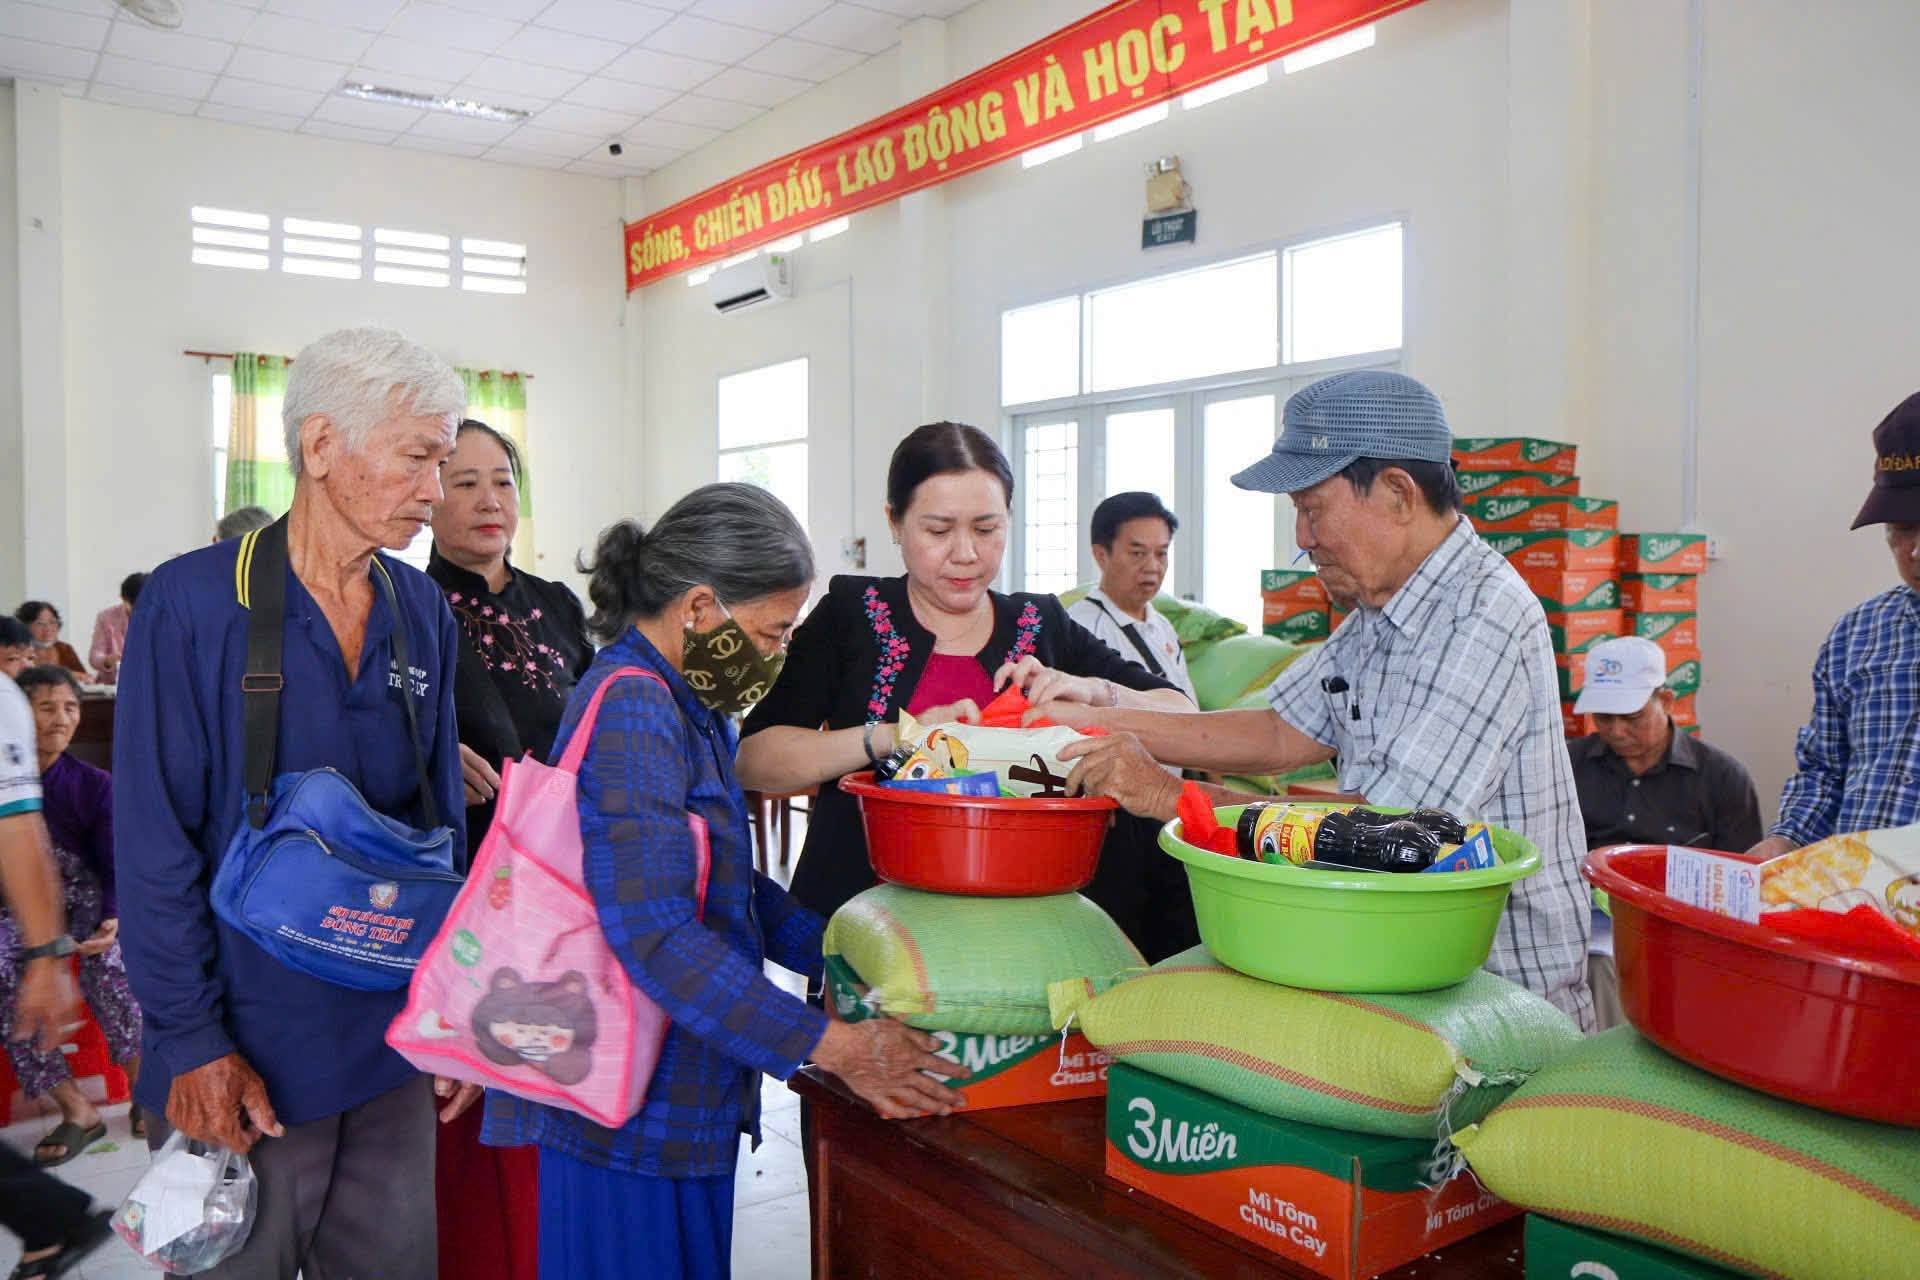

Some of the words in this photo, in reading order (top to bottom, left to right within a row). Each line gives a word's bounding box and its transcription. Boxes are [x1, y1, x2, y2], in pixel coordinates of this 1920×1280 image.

[630, 223, 690, 275] SỐNG,
[693, 186, 764, 250] CHIẾN
[767, 159, 833, 223] ĐẤU,
[837, 135, 896, 197] LAO
[902, 91, 1008, 172] ĐỘNG
[1013, 54, 1075, 127] VÀ
[1082, 13, 1187, 103] HỌC
[1050, 1071, 1097, 1087] Chua
[1239, 1204, 1287, 1238] Chua
[1289, 1226, 1328, 1258] Cay
[1248, 1187, 1271, 1212] Mì
[1274, 1198, 1318, 1232] Tôm
